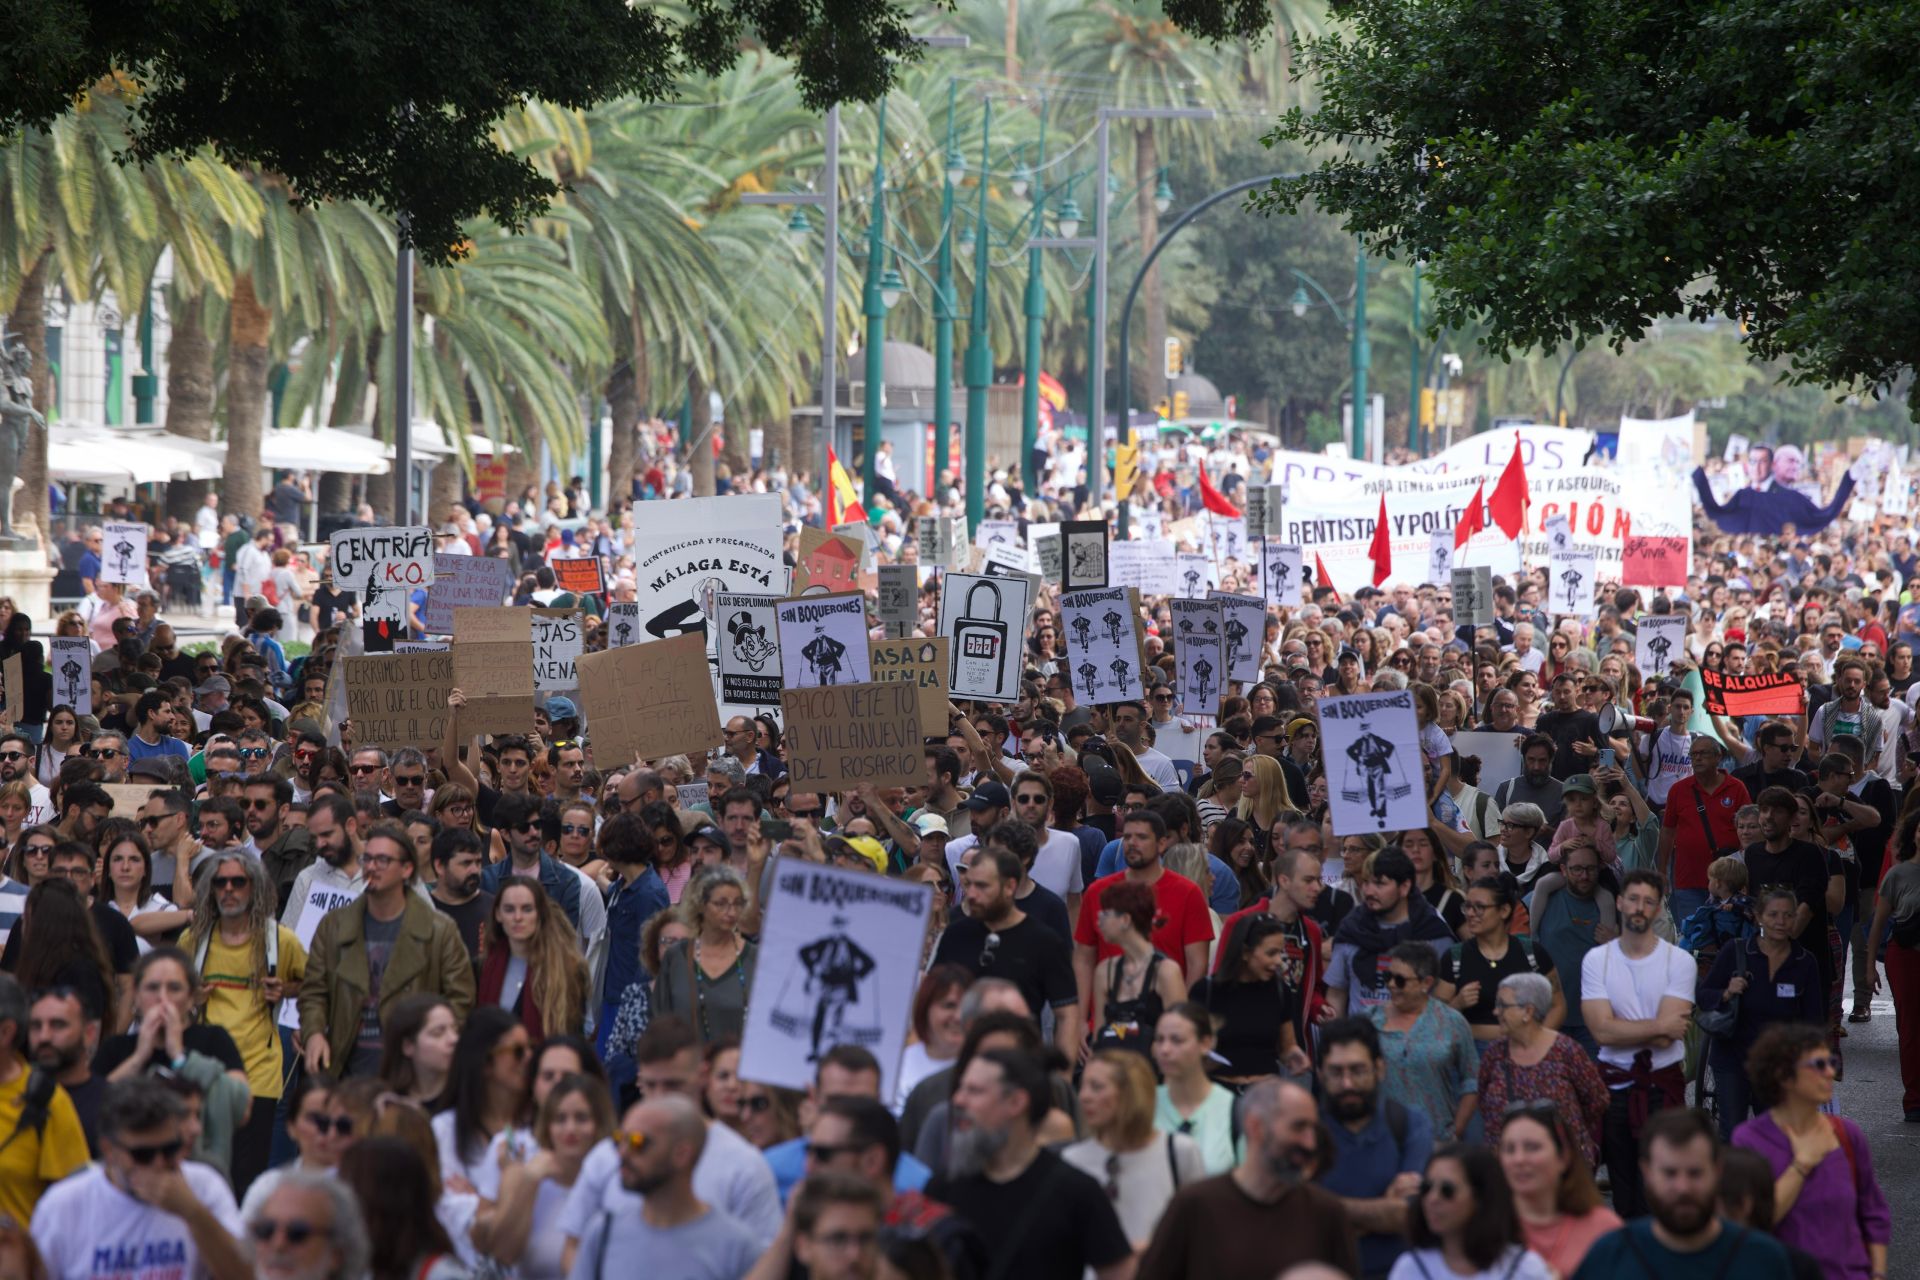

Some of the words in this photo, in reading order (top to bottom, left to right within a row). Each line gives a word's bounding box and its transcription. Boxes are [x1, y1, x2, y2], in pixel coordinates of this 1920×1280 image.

[1364, 481, 1393, 495] PARA
[1393, 515, 1405, 536] Y
[643, 538, 705, 568] GENTRIFICADA
[715, 537, 775, 560] PRECARIZADA
[650, 558, 723, 593] MÁLAGA
[728, 559, 773, 588] ESTÁ
[719, 596, 731, 606] LOS
[732, 597, 775, 608] DESPLUMAN
[1062, 598, 1074, 608] SIN
[1075, 590, 1123, 608] BOQUERONES
[1172, 602, 1182, 611] SIN
[1183, 600, 1218, 613] BOQUERONES
[781, 610, 797, 623] SIN
[800, 598, 861, 623] BOQUERONES
[1193, 636, 1219, 647] BOQUERONES
[346, 659, 404, 685] CERRAMOS
[411, 659, 425, 681] EL
[730, 678, 741, 687] NOS
[742, 678, 767, 688] REGALAN
[919, 670, 939, 688] LA
[1703, 669, 1722, 688] SE
[1725, 672, 1794, 690] ALQUILA
[348, 688, 379, 714] PARA
[386, 688, 406, 712] QUE
[410, 688, 422, 710] EL
[733, 690, 751, 698] BONOS
[752, 691, 760, 699] DE
[844, 687, 884, 718] VETE
[1322, 705, 1339, 719] SIN
[1340, 693, 1411, 719] BOQUERONES
[354, 719, 400, 743] JUEGUE
[408, 719, 424, 741] AL
[787, 725, 799, 750] A
[811, 718, 917, 750] VILLANUEVA
[793, 758, 827, 782] DEL
[840, 754, 916, 779] ROSARIO
[310, 892, 328, 910] SIN
[810, 873, 925, 917] BOQUERONES
